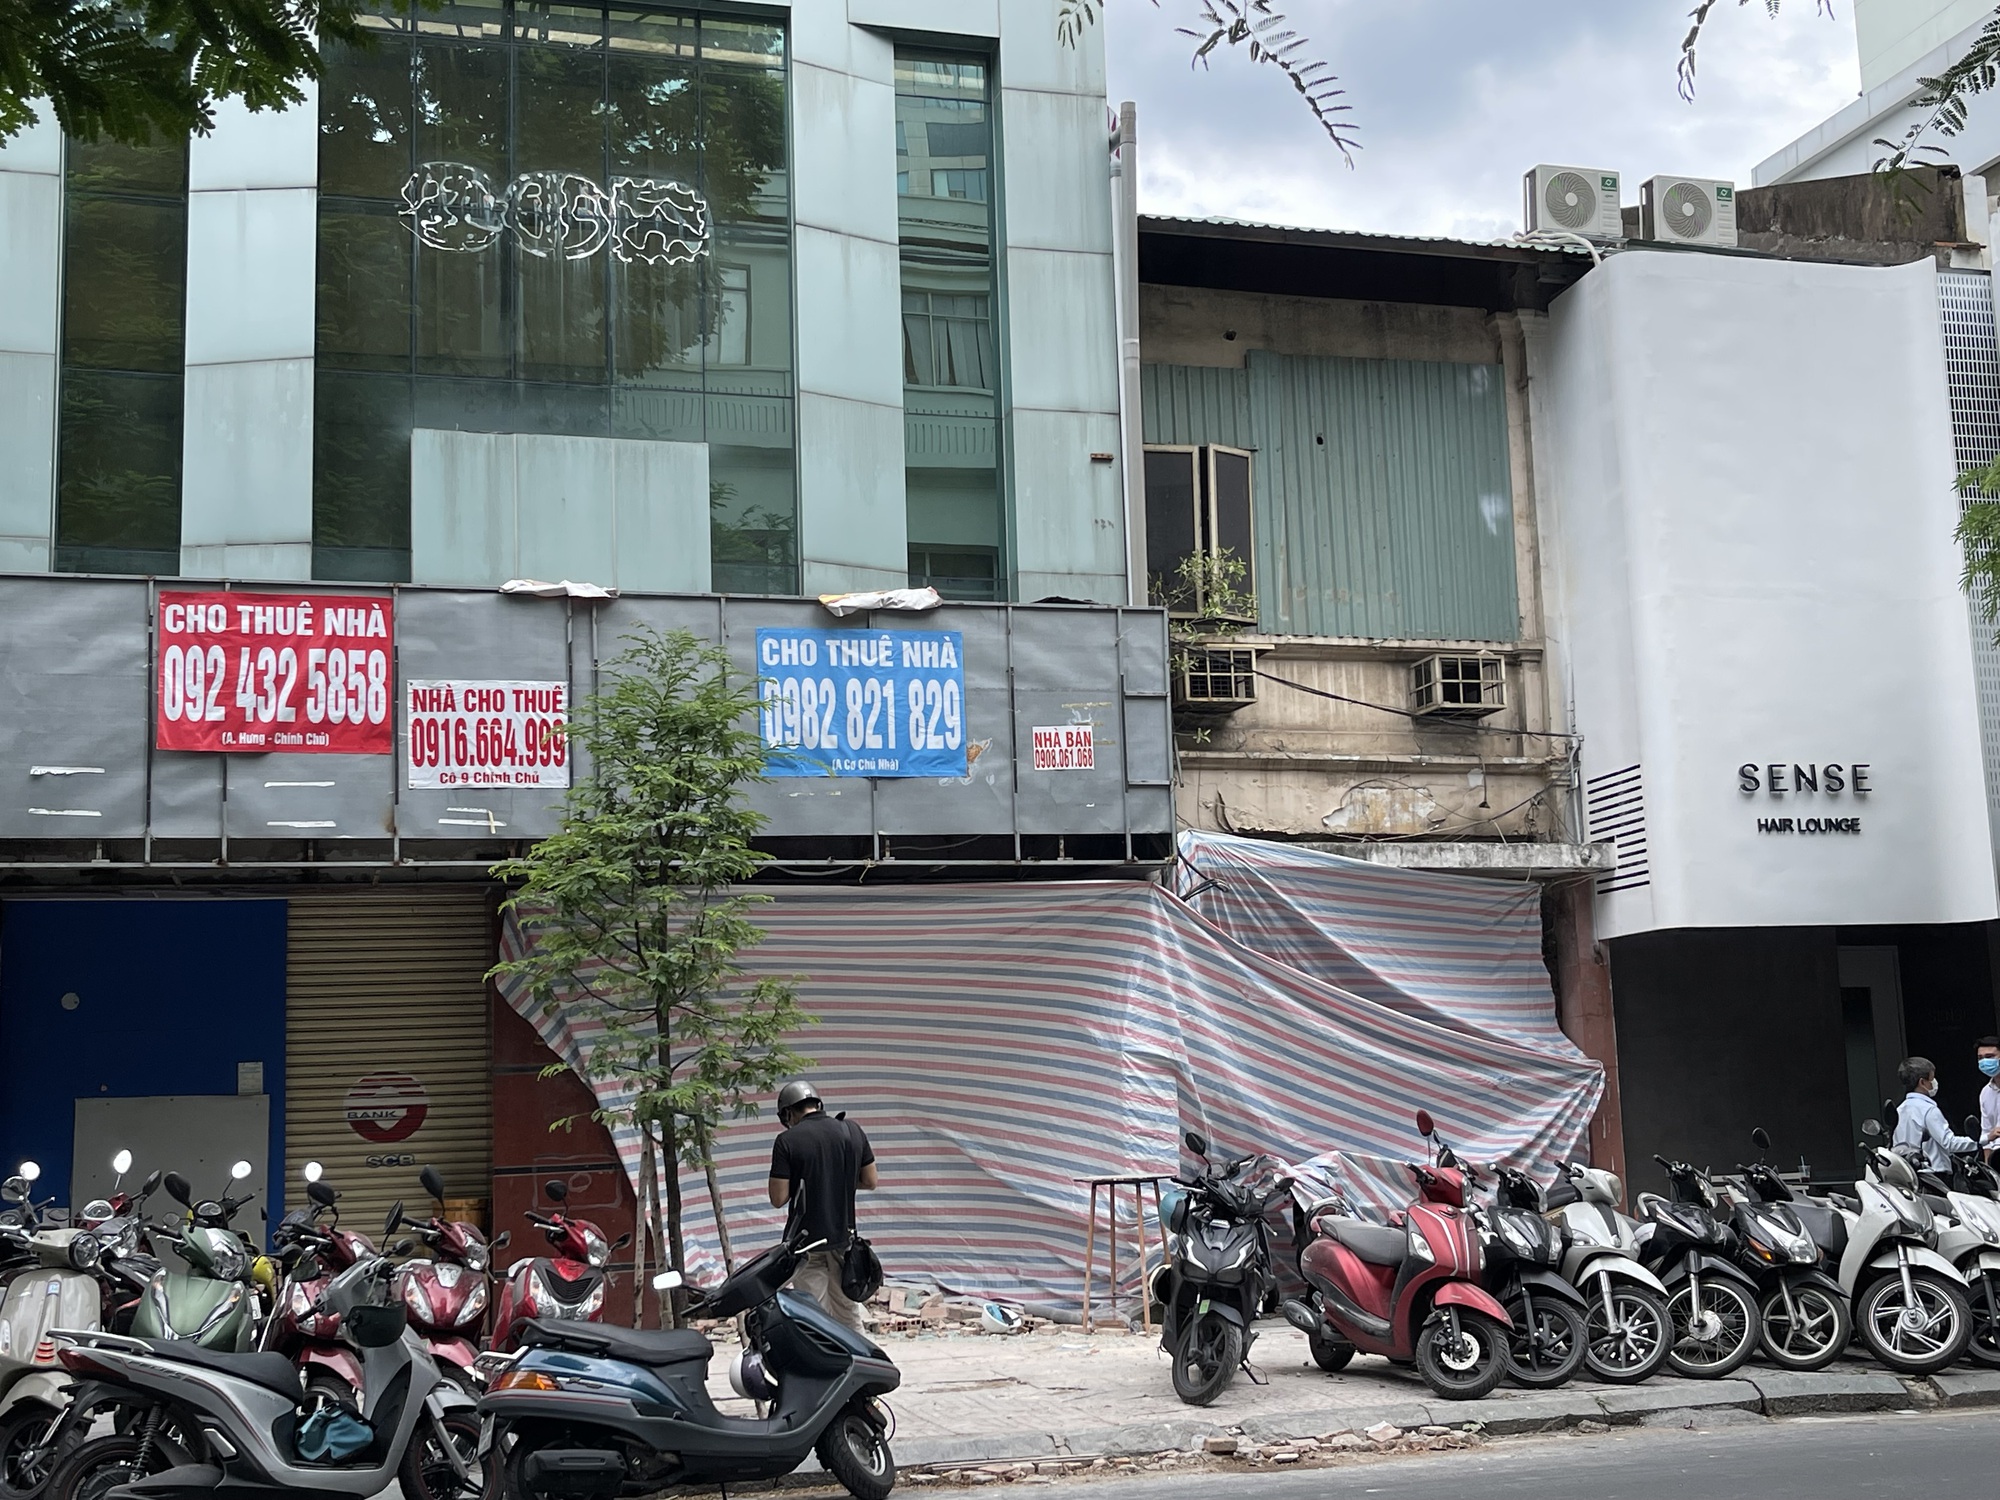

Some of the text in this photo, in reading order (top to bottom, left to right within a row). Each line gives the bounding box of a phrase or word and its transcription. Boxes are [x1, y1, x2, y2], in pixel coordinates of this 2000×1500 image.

[165, 601, 387, 638] CHO THUÊ NHÀ
[762, 634, 958, 669] CHO THUÊ NHÀ
[164, 644, 387, 725] 092 432 5858
[413, 685, 563, 713] NHÀ CHO THUÊ
[764, 676, 961, 751] 0982 821 829
[222, 731, 236, 745] (A.
[238, 732, 266, 745] Hưng
[274, 732, 303, 745] Chính
[305, 732, 329, 746] Chủ)
[412, 717, 566, 768] 0916.664.999
[1034, 727, 1092, 748] NHÀ BÁN
[832, 758, 842, 771] (A
[858, 757, 876, 771] Chủ
[878, 758, 899, 771] Nhà)
[1035, 748, 1093, 768] 0908.061.068
[440, 771, 539, 784] Cô 9 Chính Chủ
[1738, 763, 1872, 792] SENSE
[1757, 817, 1861, 834] HAIR LOUNGE
[348, 1110, 398, 1119] BANK
[366, 1153, 416, 1169] SCB
